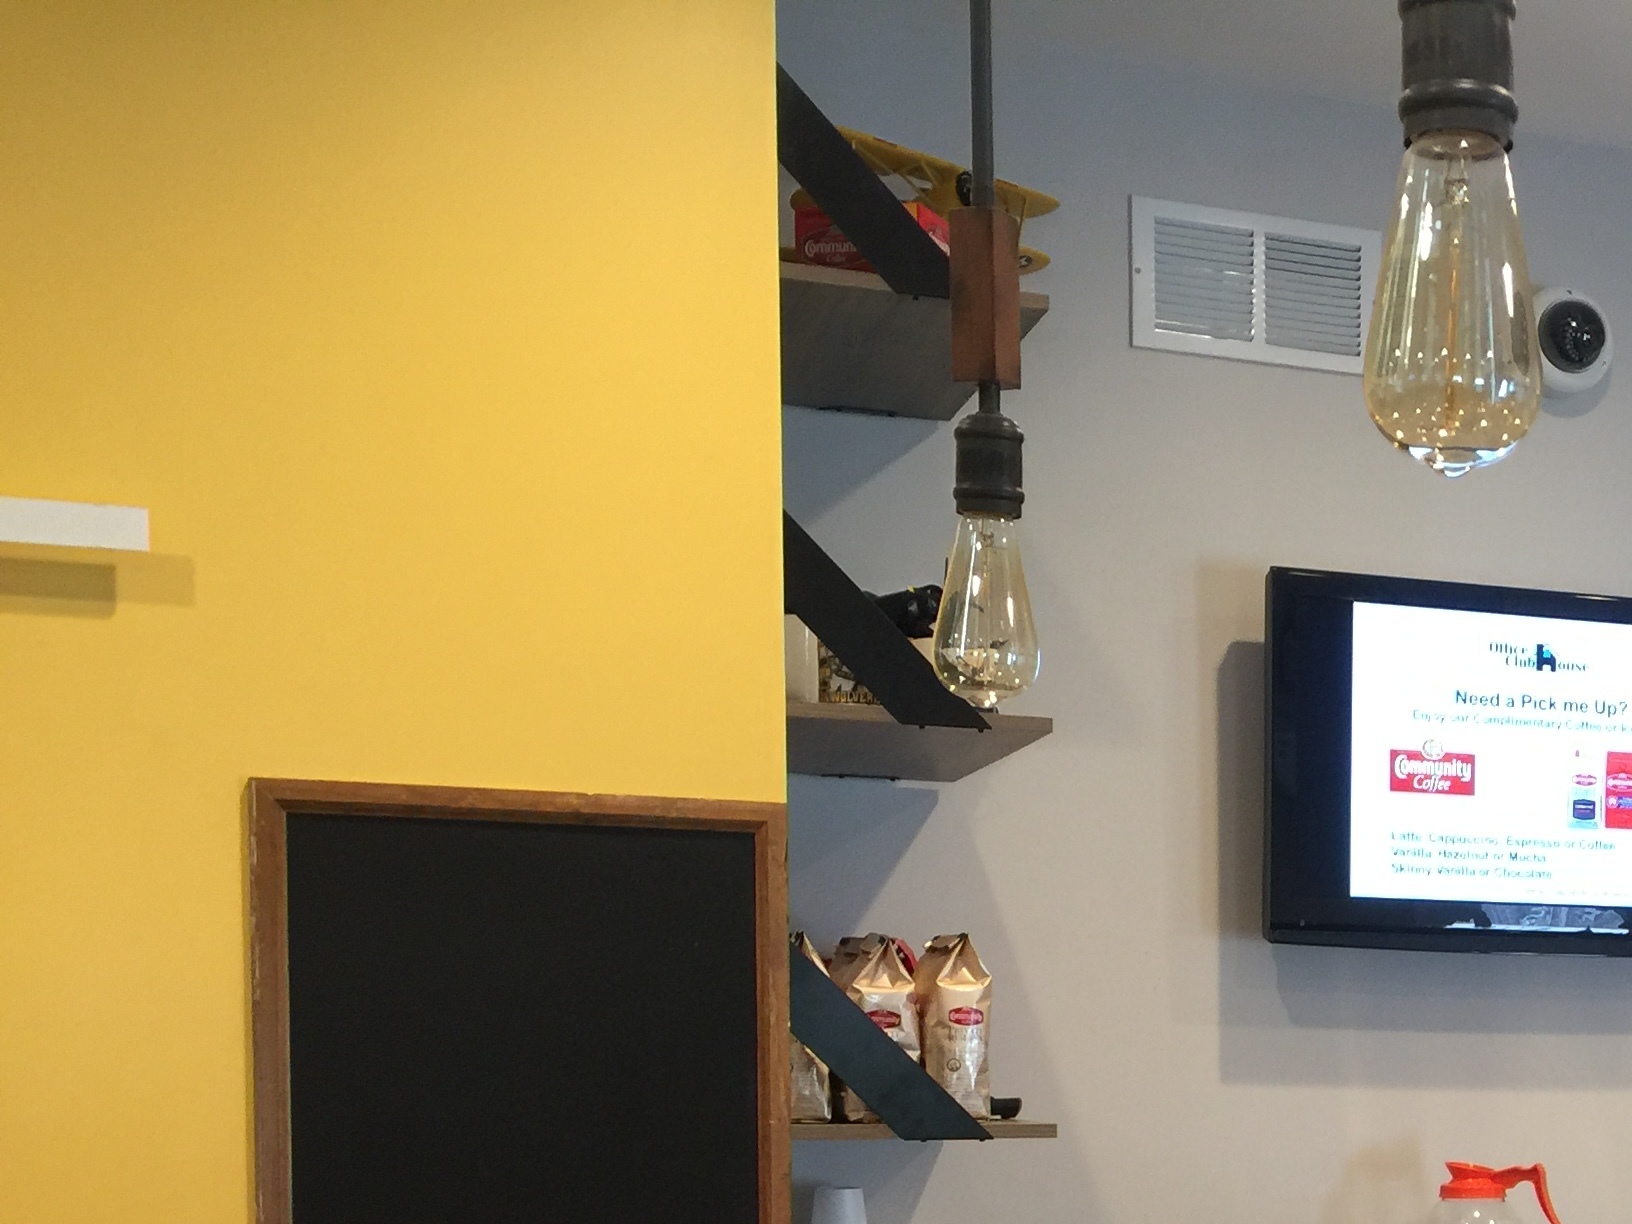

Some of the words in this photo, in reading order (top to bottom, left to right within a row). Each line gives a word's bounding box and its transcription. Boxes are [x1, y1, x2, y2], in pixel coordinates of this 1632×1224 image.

[1489, 641, 1529, 655] Office
[1455, 689, 1500, 707] Need
[1505, 695, 1515, 708] a
[1521, 694, 1557, 711] Pick
[1563, 700, 1589, 714] me
[1595, 700, 1629, 719] Up?
[1394, 754, 1472, 782] Community
[1413, 775, 1452, 793] Coffee
